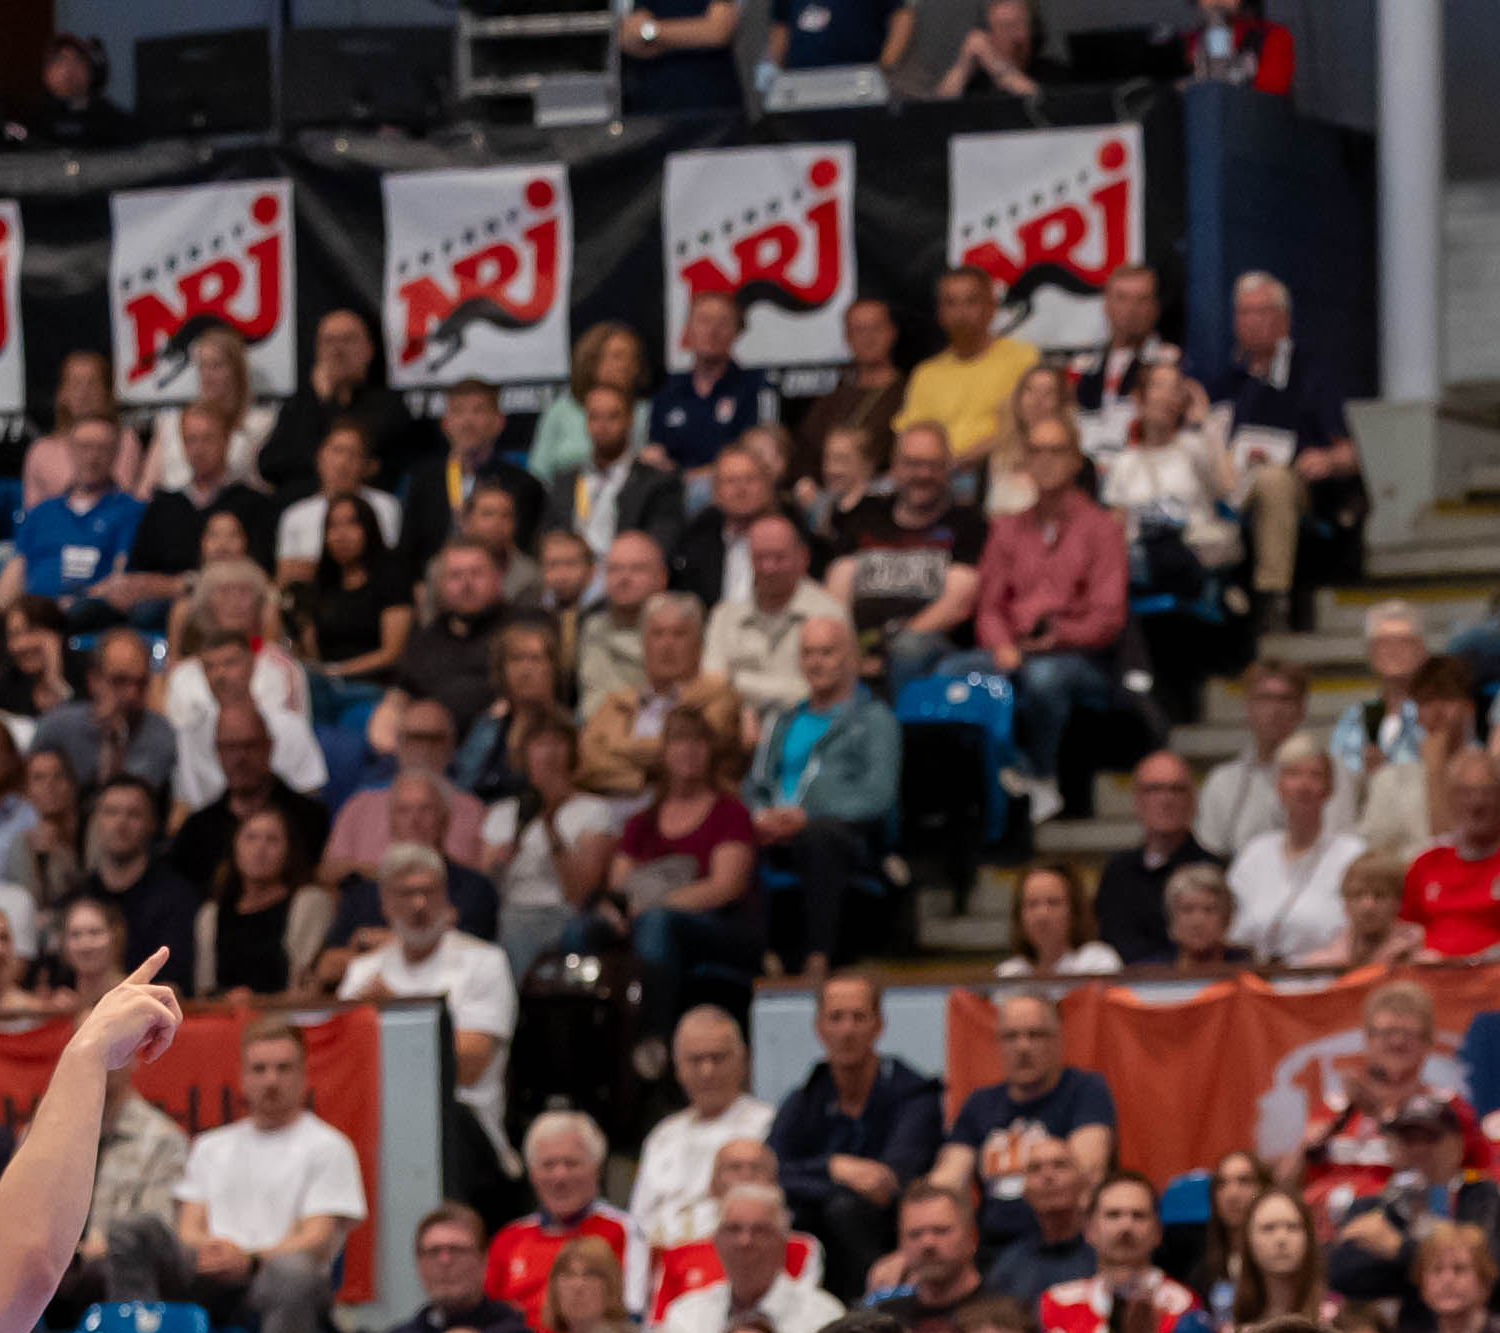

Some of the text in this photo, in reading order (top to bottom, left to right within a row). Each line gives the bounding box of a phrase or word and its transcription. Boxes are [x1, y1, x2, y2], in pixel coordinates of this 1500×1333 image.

[125, 194, 281, 386] NRJ
[399, 179, 559, 368] NRJ
[680, 157, 842, 350] NRJ
